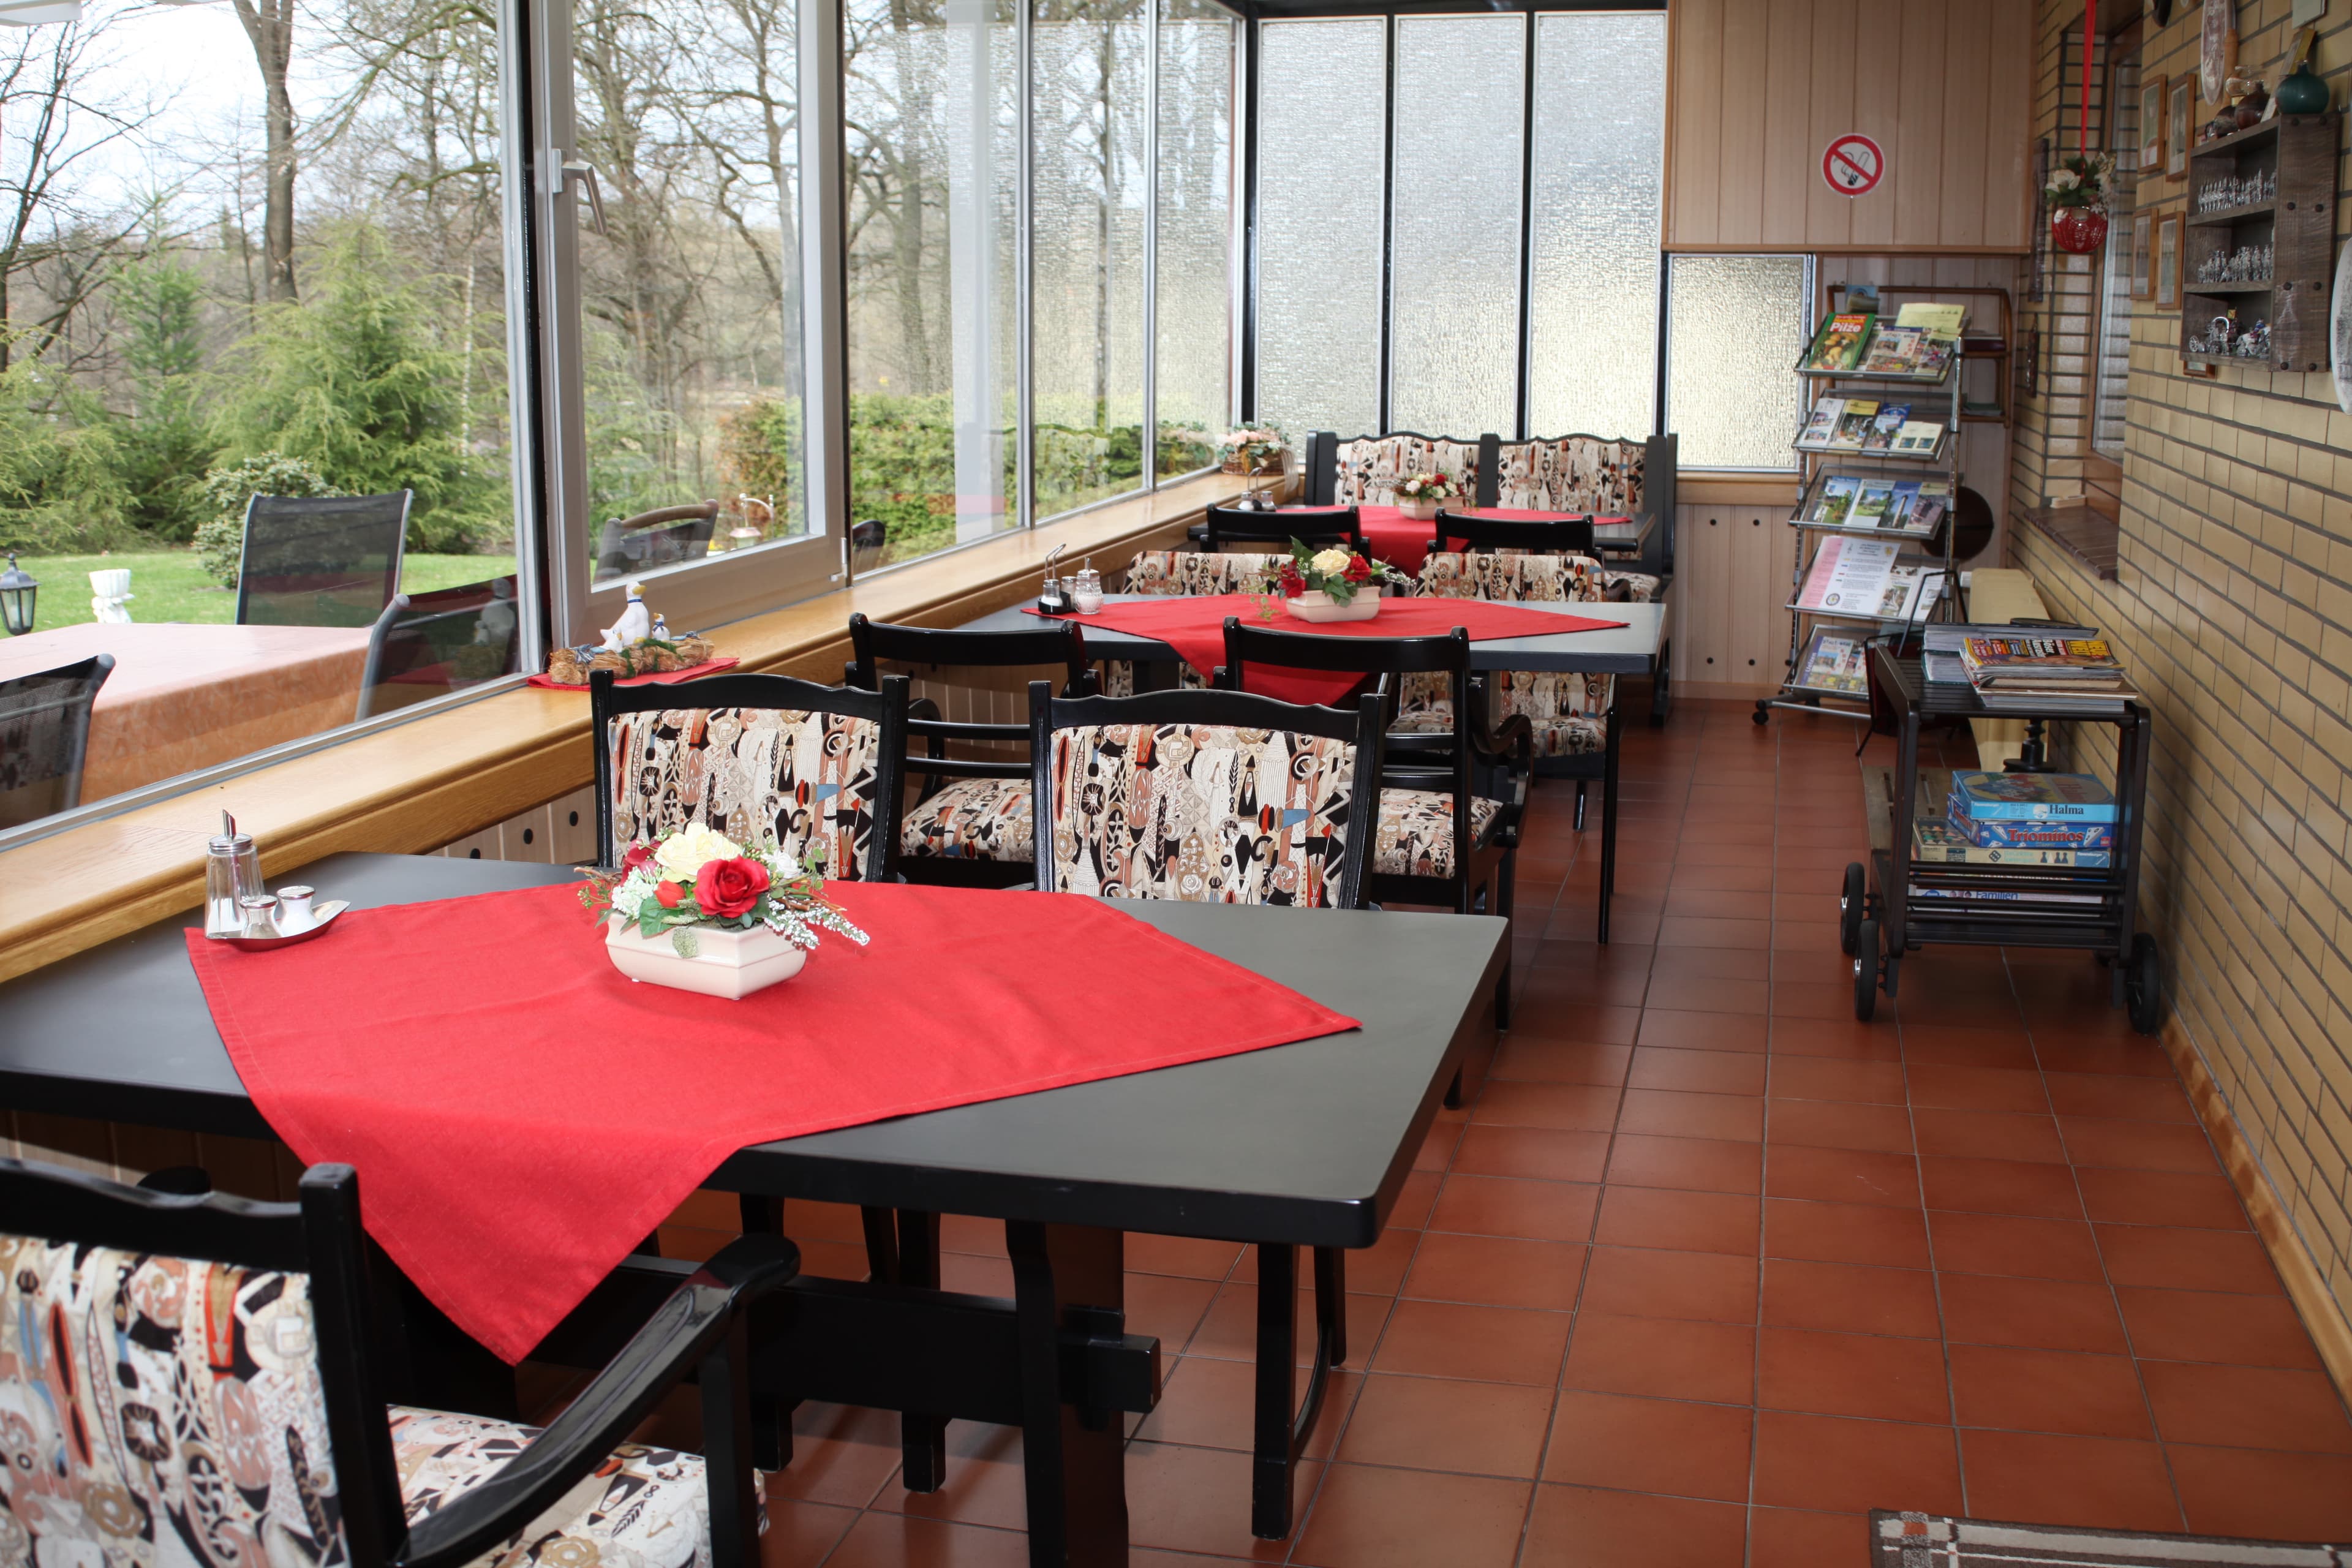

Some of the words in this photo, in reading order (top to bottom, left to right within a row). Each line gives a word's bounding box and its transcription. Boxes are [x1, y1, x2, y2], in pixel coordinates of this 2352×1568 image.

[1830, 323, 1861, 332] Pilze
[2049, 804, 2084, 815] Halma
[2007, 829, 2085, 842] Triominos
[1976, 891, 2019, 900] Familien
